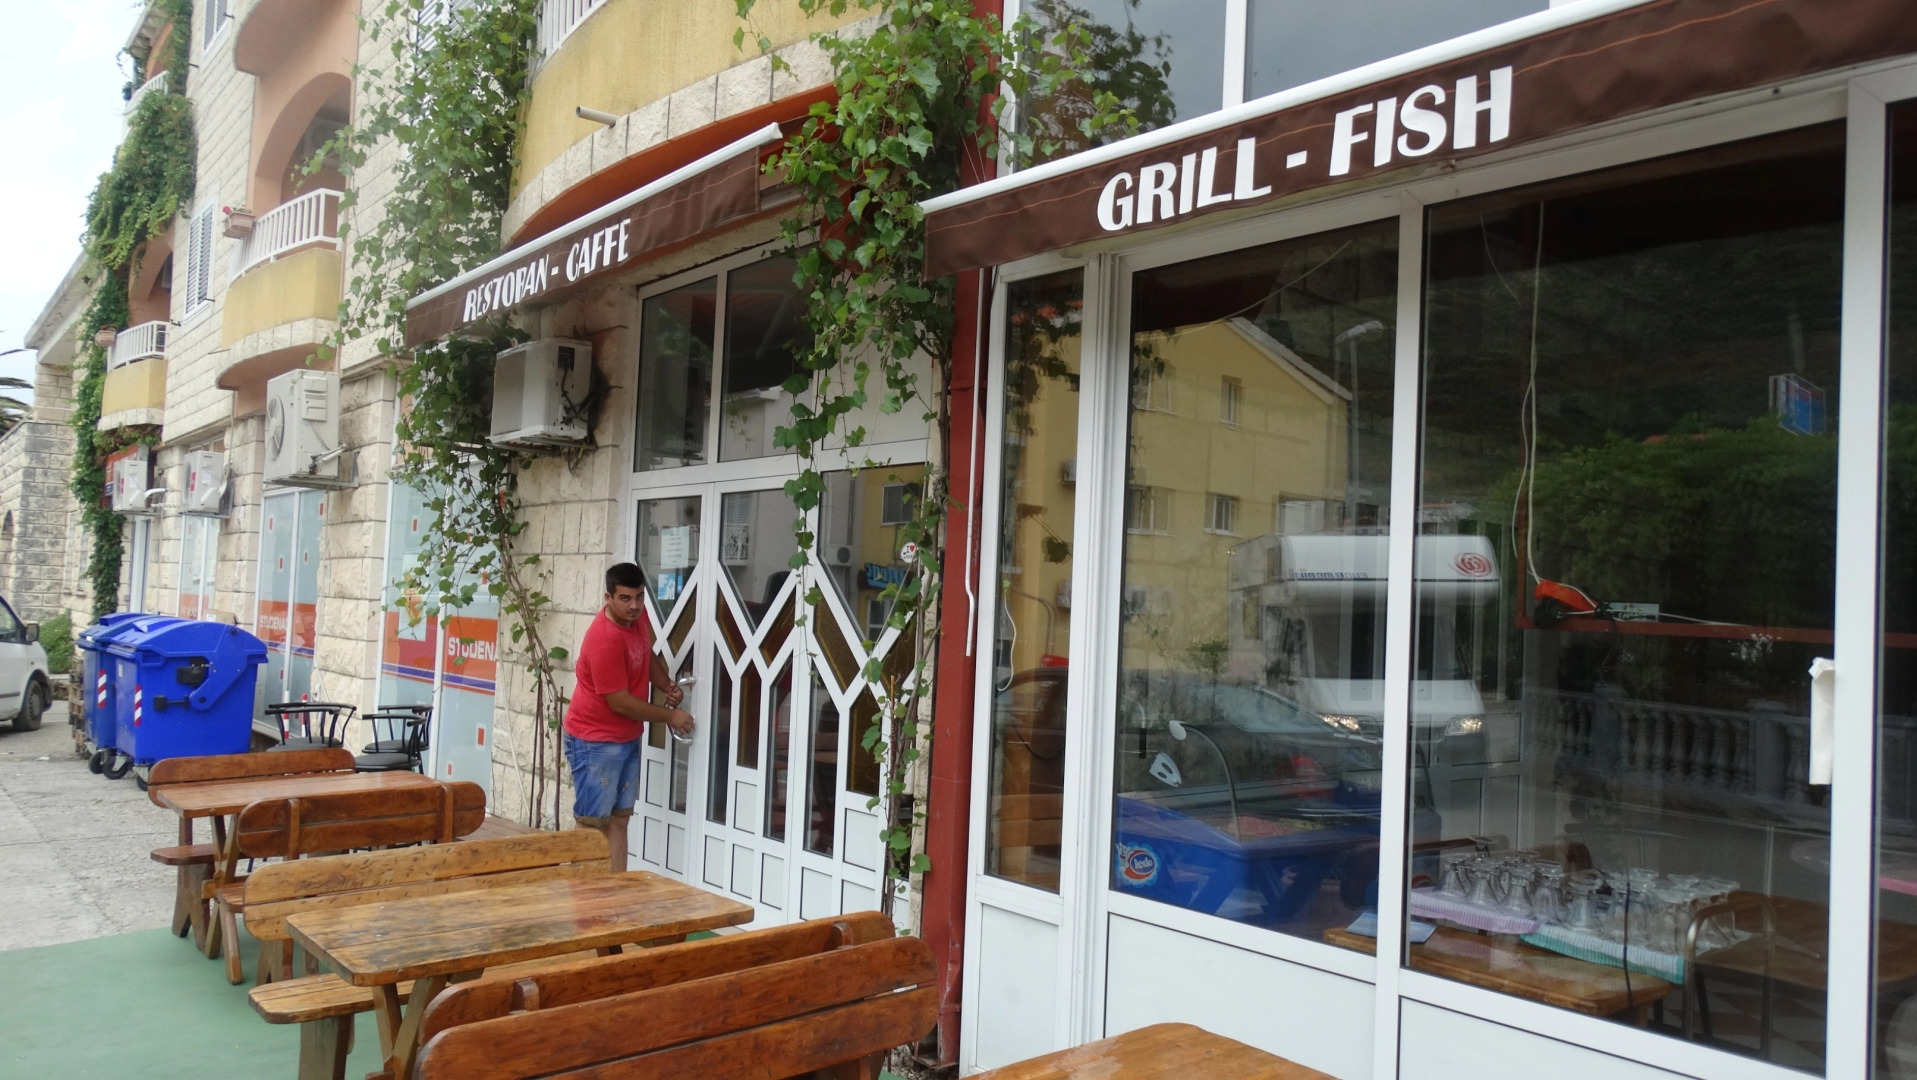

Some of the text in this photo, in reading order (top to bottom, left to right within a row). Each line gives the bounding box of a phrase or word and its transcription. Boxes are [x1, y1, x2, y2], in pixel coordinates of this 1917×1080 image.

[1097, 137, 1272, 231] GRILL
[1329, 66, 1513, 177] FISH
[463, 254, 549, 323] RESTORAN
[566, 218, 631, 282] CAFFE
